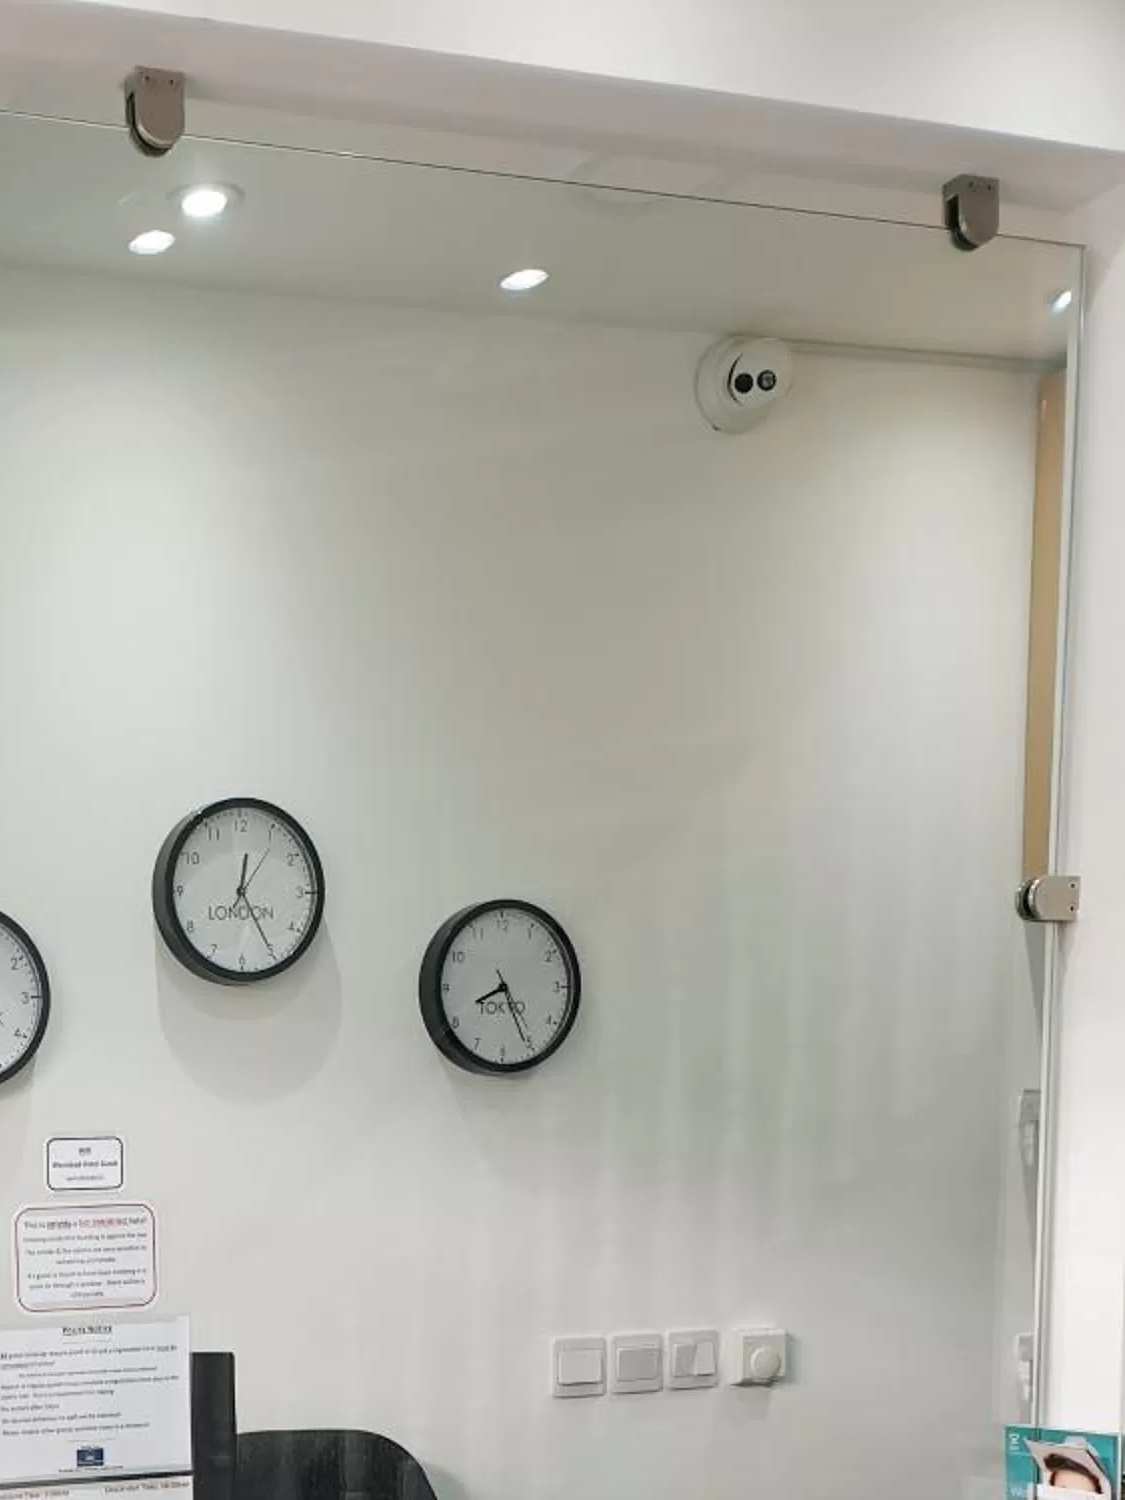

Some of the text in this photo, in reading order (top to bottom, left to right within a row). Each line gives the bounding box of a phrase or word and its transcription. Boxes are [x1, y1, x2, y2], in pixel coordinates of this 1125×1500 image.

[234, 819, 248, 832] 12
[208, 828, 220, 841] 11
[186, 852, 200, 865] 10
[176, 885, 184, 897] 9
[208, 906, 274, 921] LONDON
[239, 953, 246, 965] 6
[452, 951, 465, 964] 10
[20, 992, 29, 1004] 3
[477, 1001, 526, 1015] TOKYO
